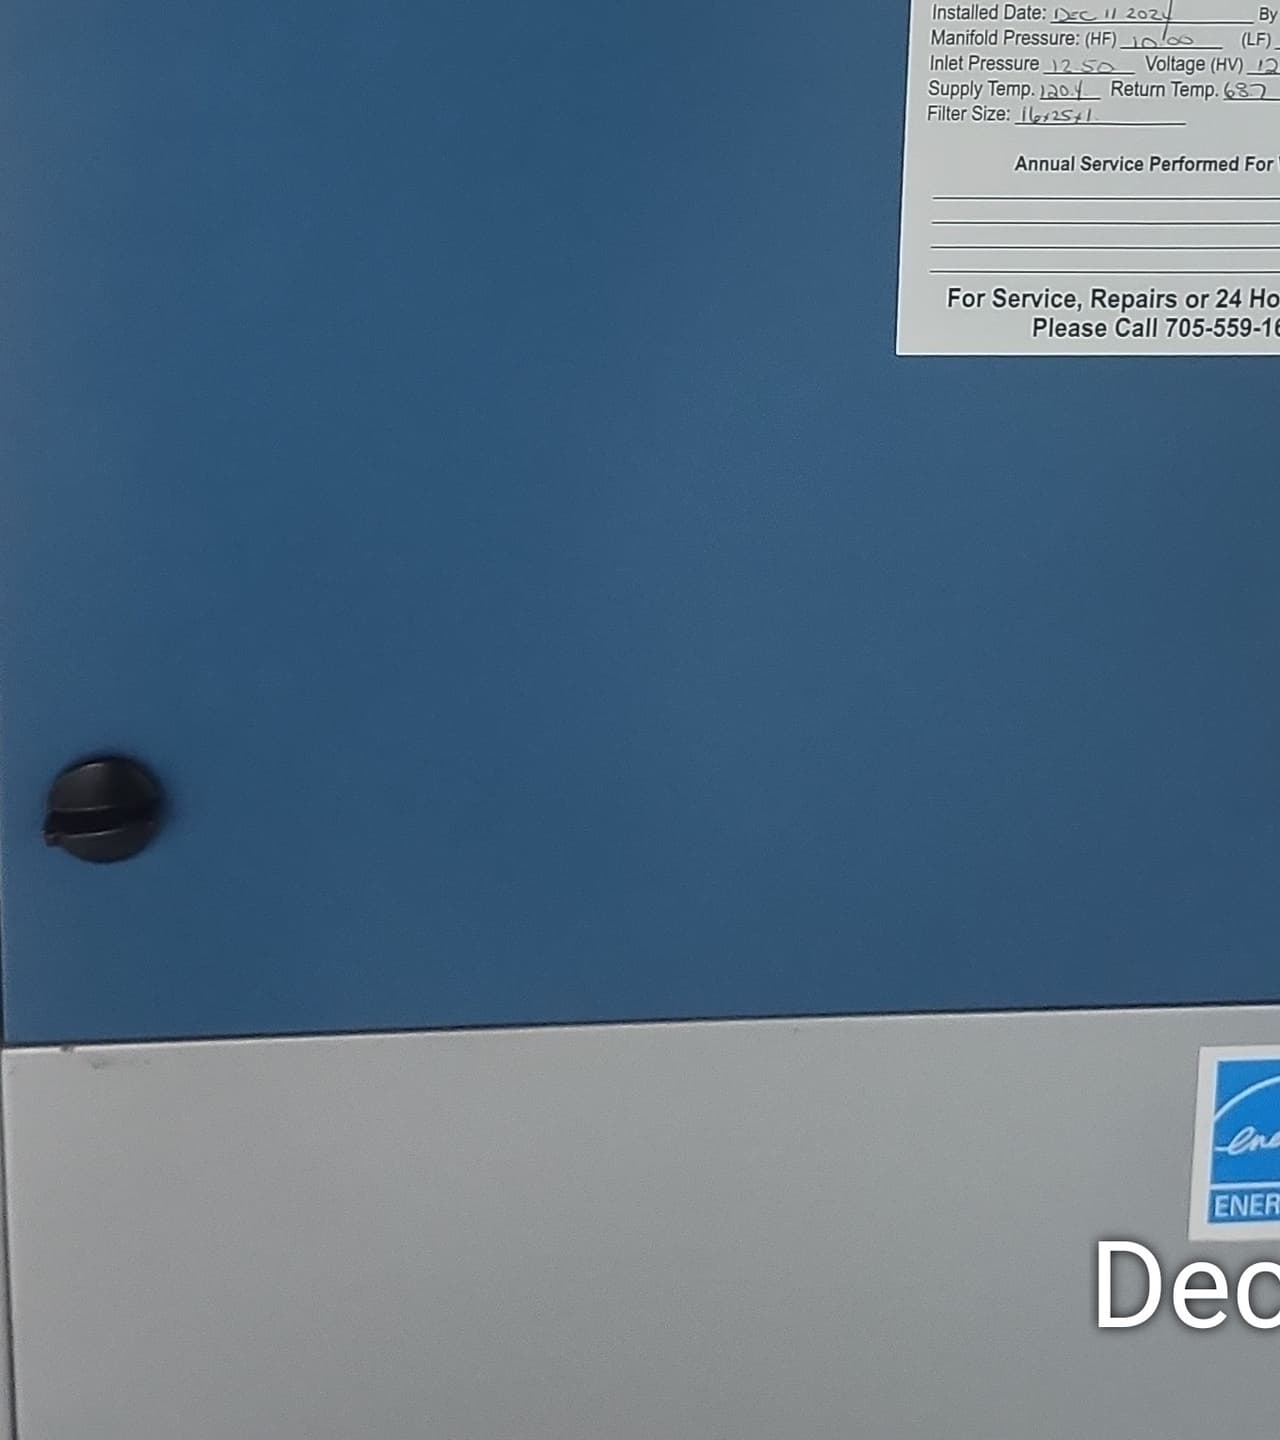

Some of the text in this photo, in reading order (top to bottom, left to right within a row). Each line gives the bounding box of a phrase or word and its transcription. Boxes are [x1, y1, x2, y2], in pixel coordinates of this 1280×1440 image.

[932, 3, 999, 21] Installed
[1004, 4, 1047, 21] Date:
[1259, 7, 1277, 24] By
[931, 29, 1272, 49] Manifold Pressure: (HF) (LF)
[930, 55, 965, 71] Inlet
[968, 55, 1040, 72] Pressure
[1145, 55, 1206, 75] Voltage
[1210, 58, 1244, 76] (HV)
[928, 80, 983, 99] Supply
[987, 80, 1035, 99] Temp.
[1111, 81, 1166, 97] Return
[1171, 81, 1219, 100] Temp.
[927, 105, 1011, 122] Filter Size:
[1014, 156, 1075, 172] Annual
[1080, 156, 1144, 172] Service
[1149, 156, 1239, 172] Performed
[1245, 156, 1274, 172] For
[947, 288, 986, 308] For
[992, 287, 1083, 311] Service,
[1091, 287, 1178, 312] Repairs
[1185, 292, 1210, 309] or
[1215, 288, 1242, 309] 24
[1032, 317, 1107, 338] Please
[1115, 317, 1158, 338] Call
